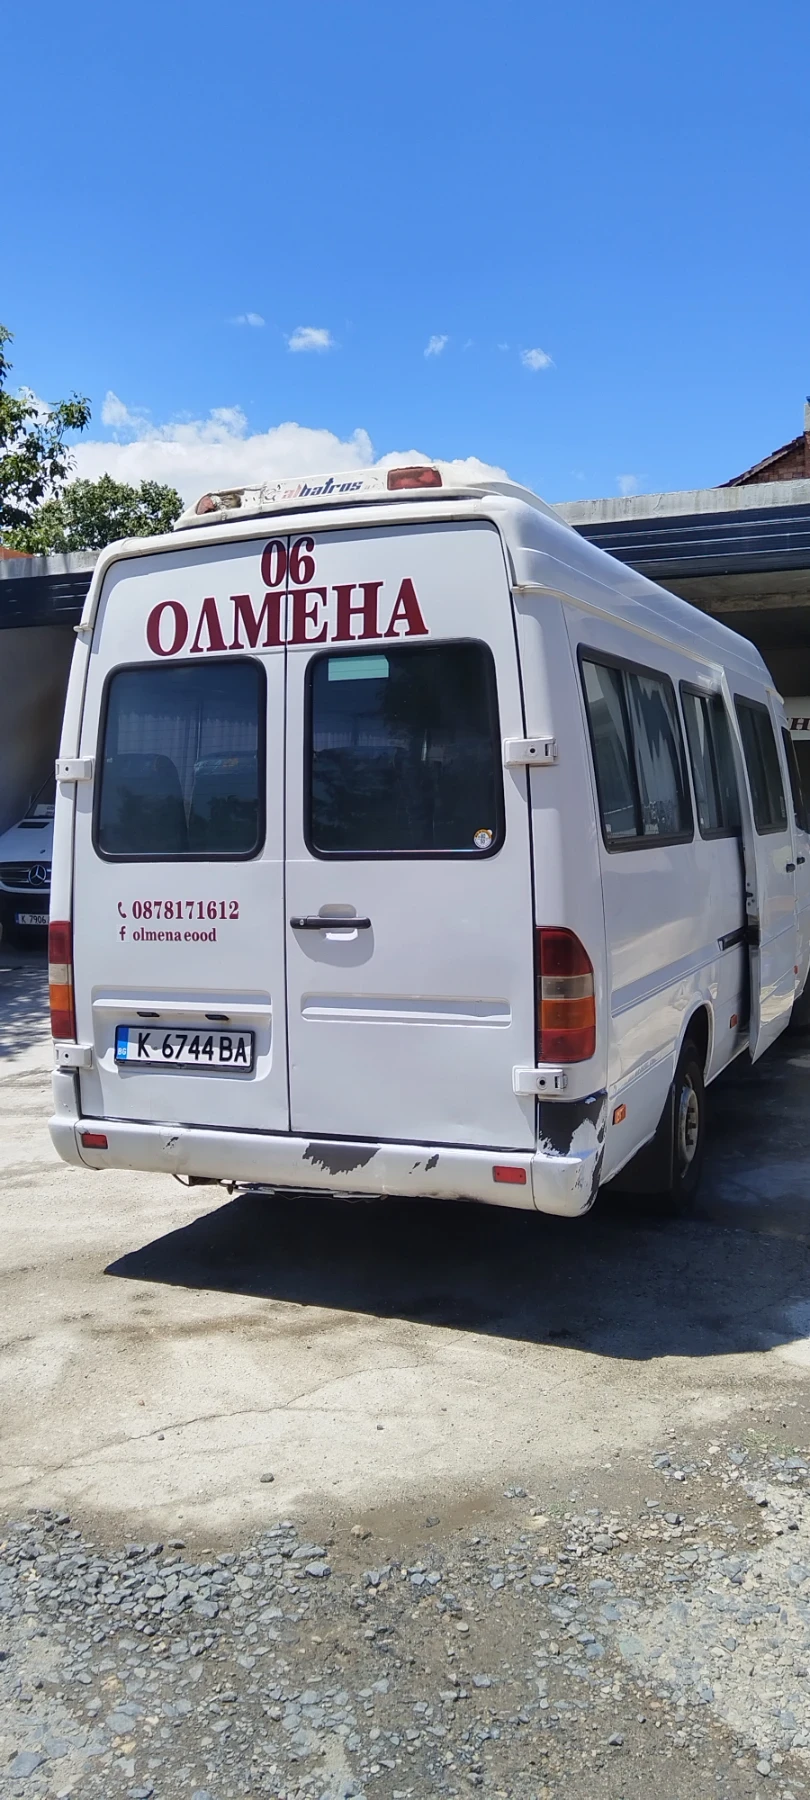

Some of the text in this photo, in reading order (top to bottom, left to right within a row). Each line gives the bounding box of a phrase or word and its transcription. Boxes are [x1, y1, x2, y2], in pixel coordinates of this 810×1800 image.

[281, 477, 363, 499] albatros
[261, 537, 315, 588] 06
[146, 578, 429, 657] ОЛМЕНА
[132, 900, 239, 920] 0878171612
[132, 927, 217, 942] olmena eood
[137, 1032, 151, 1058] K
